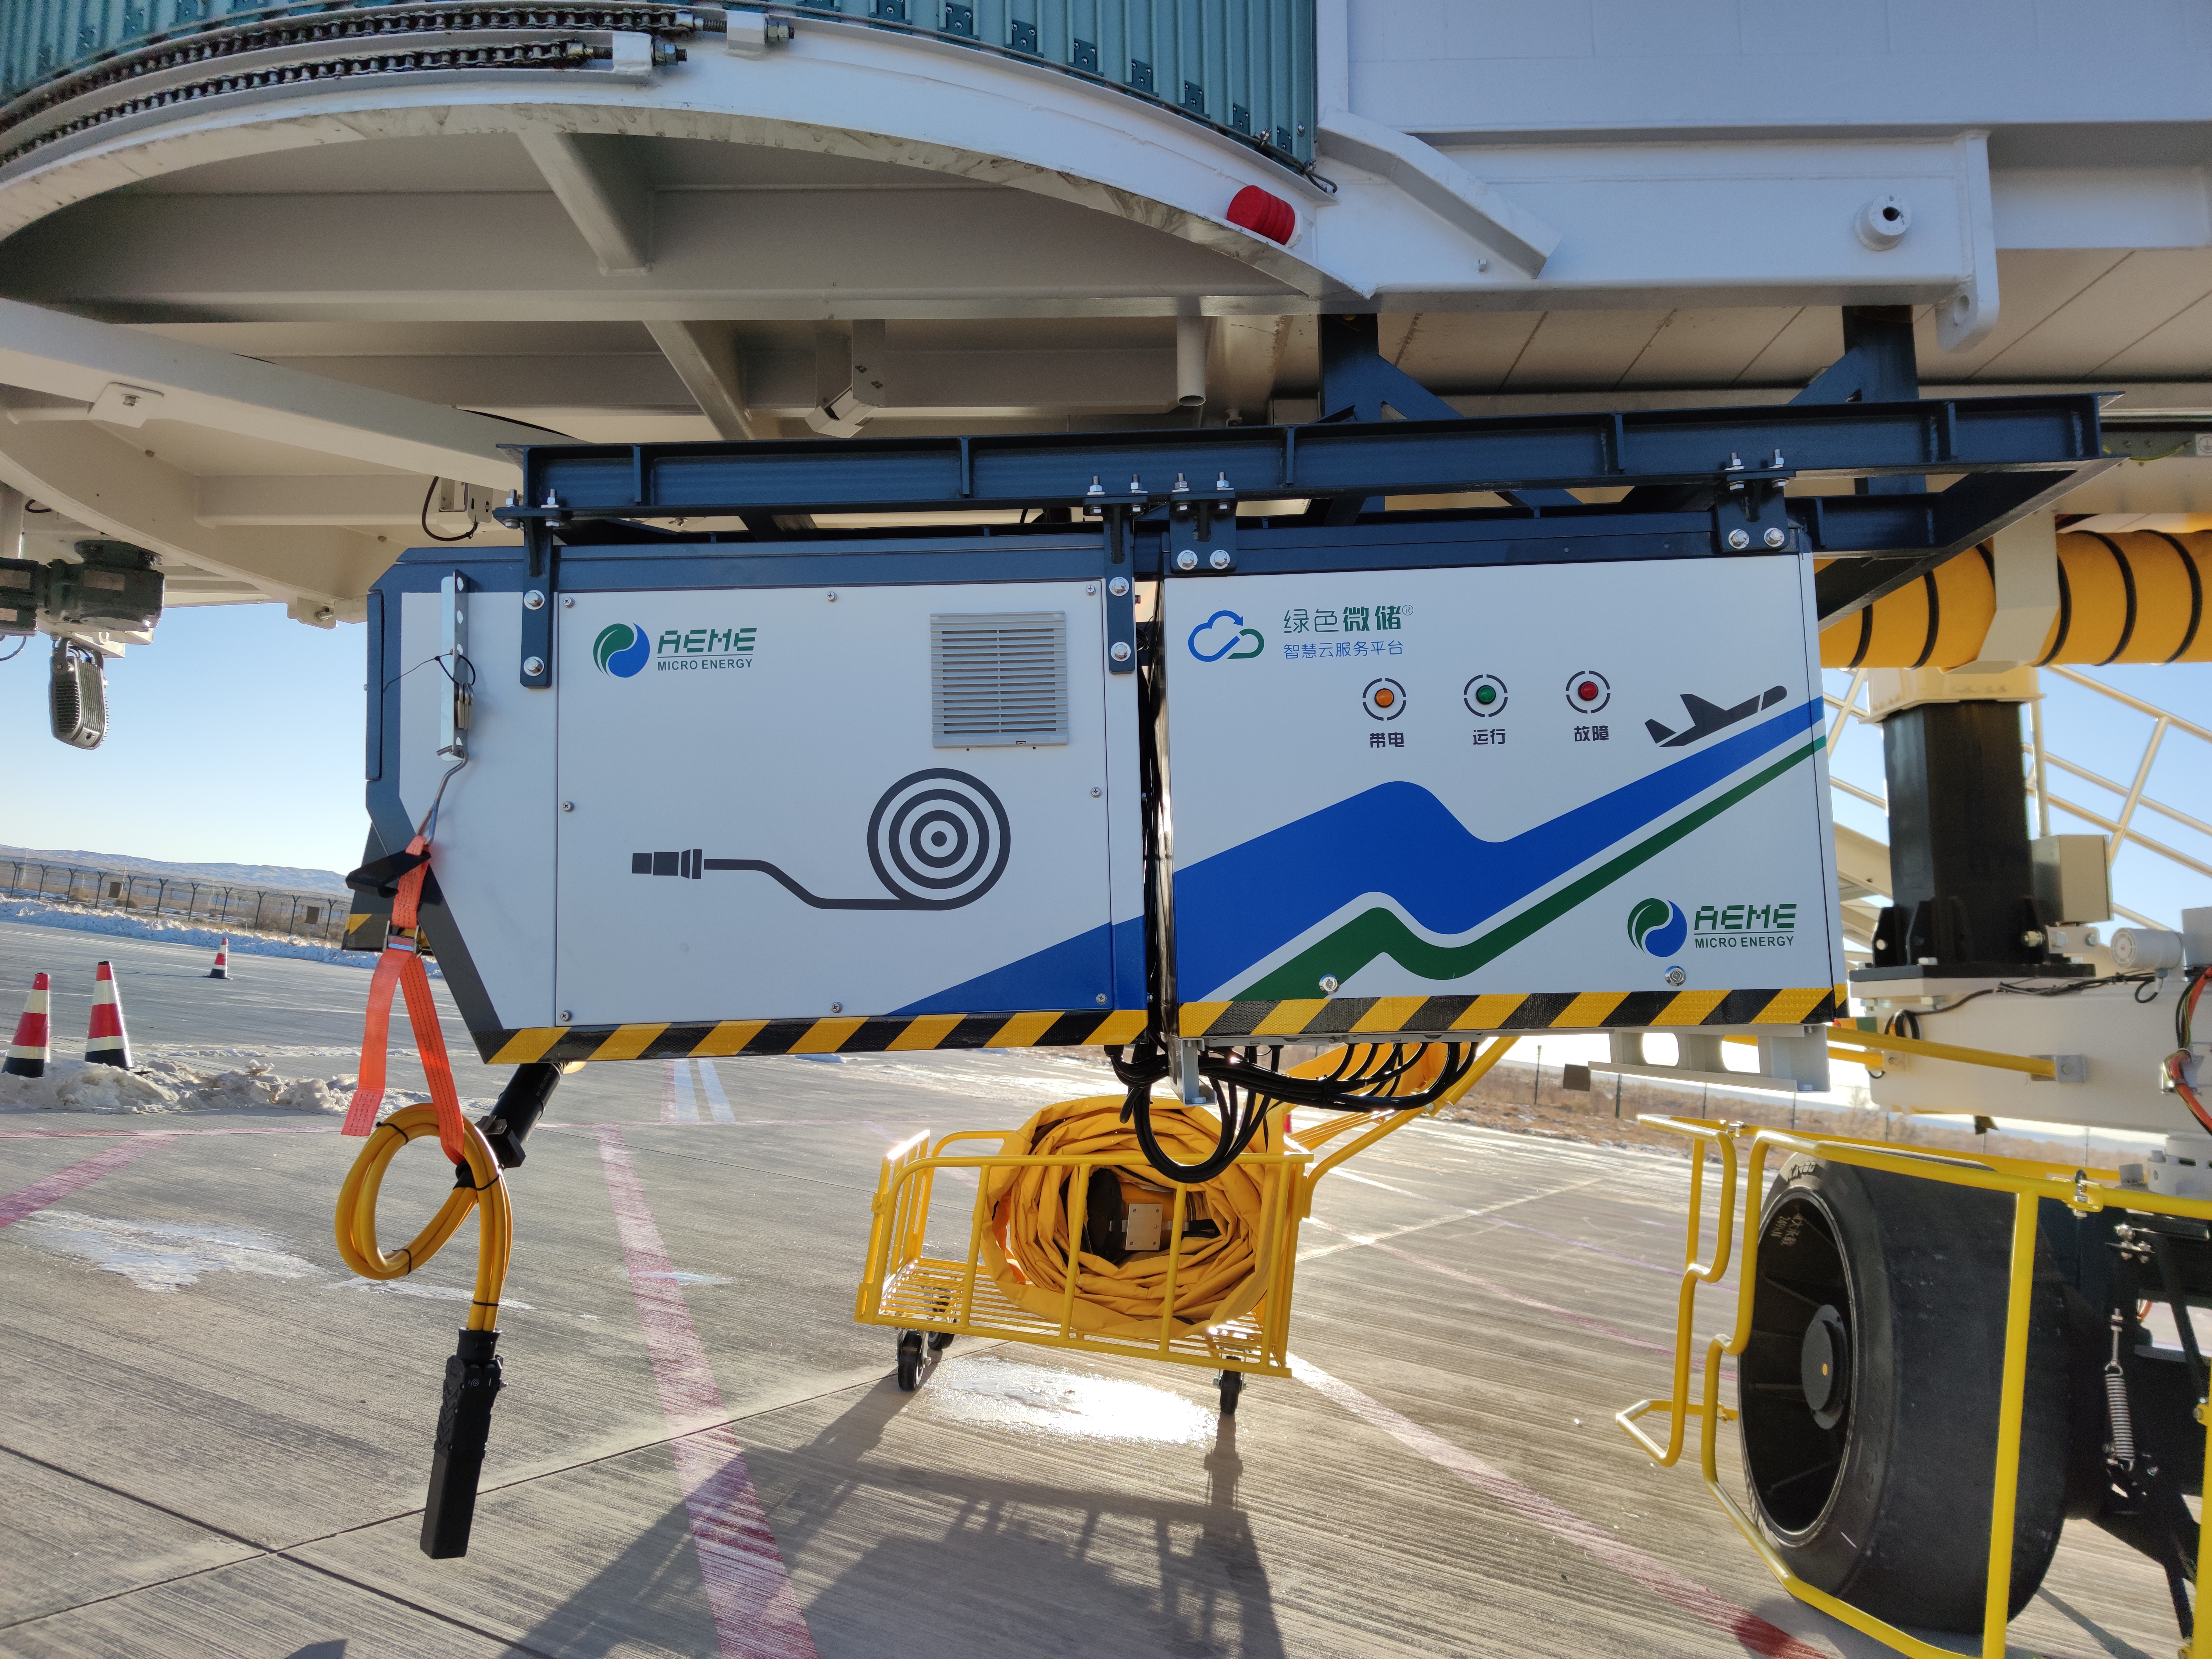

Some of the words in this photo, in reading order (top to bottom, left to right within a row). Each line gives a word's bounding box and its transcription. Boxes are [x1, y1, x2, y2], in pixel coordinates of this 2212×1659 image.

[657, 628, 757, 654] AEME
[1284, 640, 1403, 659] 智慧云服务平台
[658, 660, 698, 671] MICRO
[702, 659, 753, 669] ENERGY
[1370, 732, 1405, 748] 带电
[1473, 729, 1506, 745] 运行
[1574, 725, 1609, 742] 故障
[1694, 904, 1797, 930] AEME
[1695, 938, 1737, 948] MICRO
[1741, 936, 1794, 947] ENERGY
